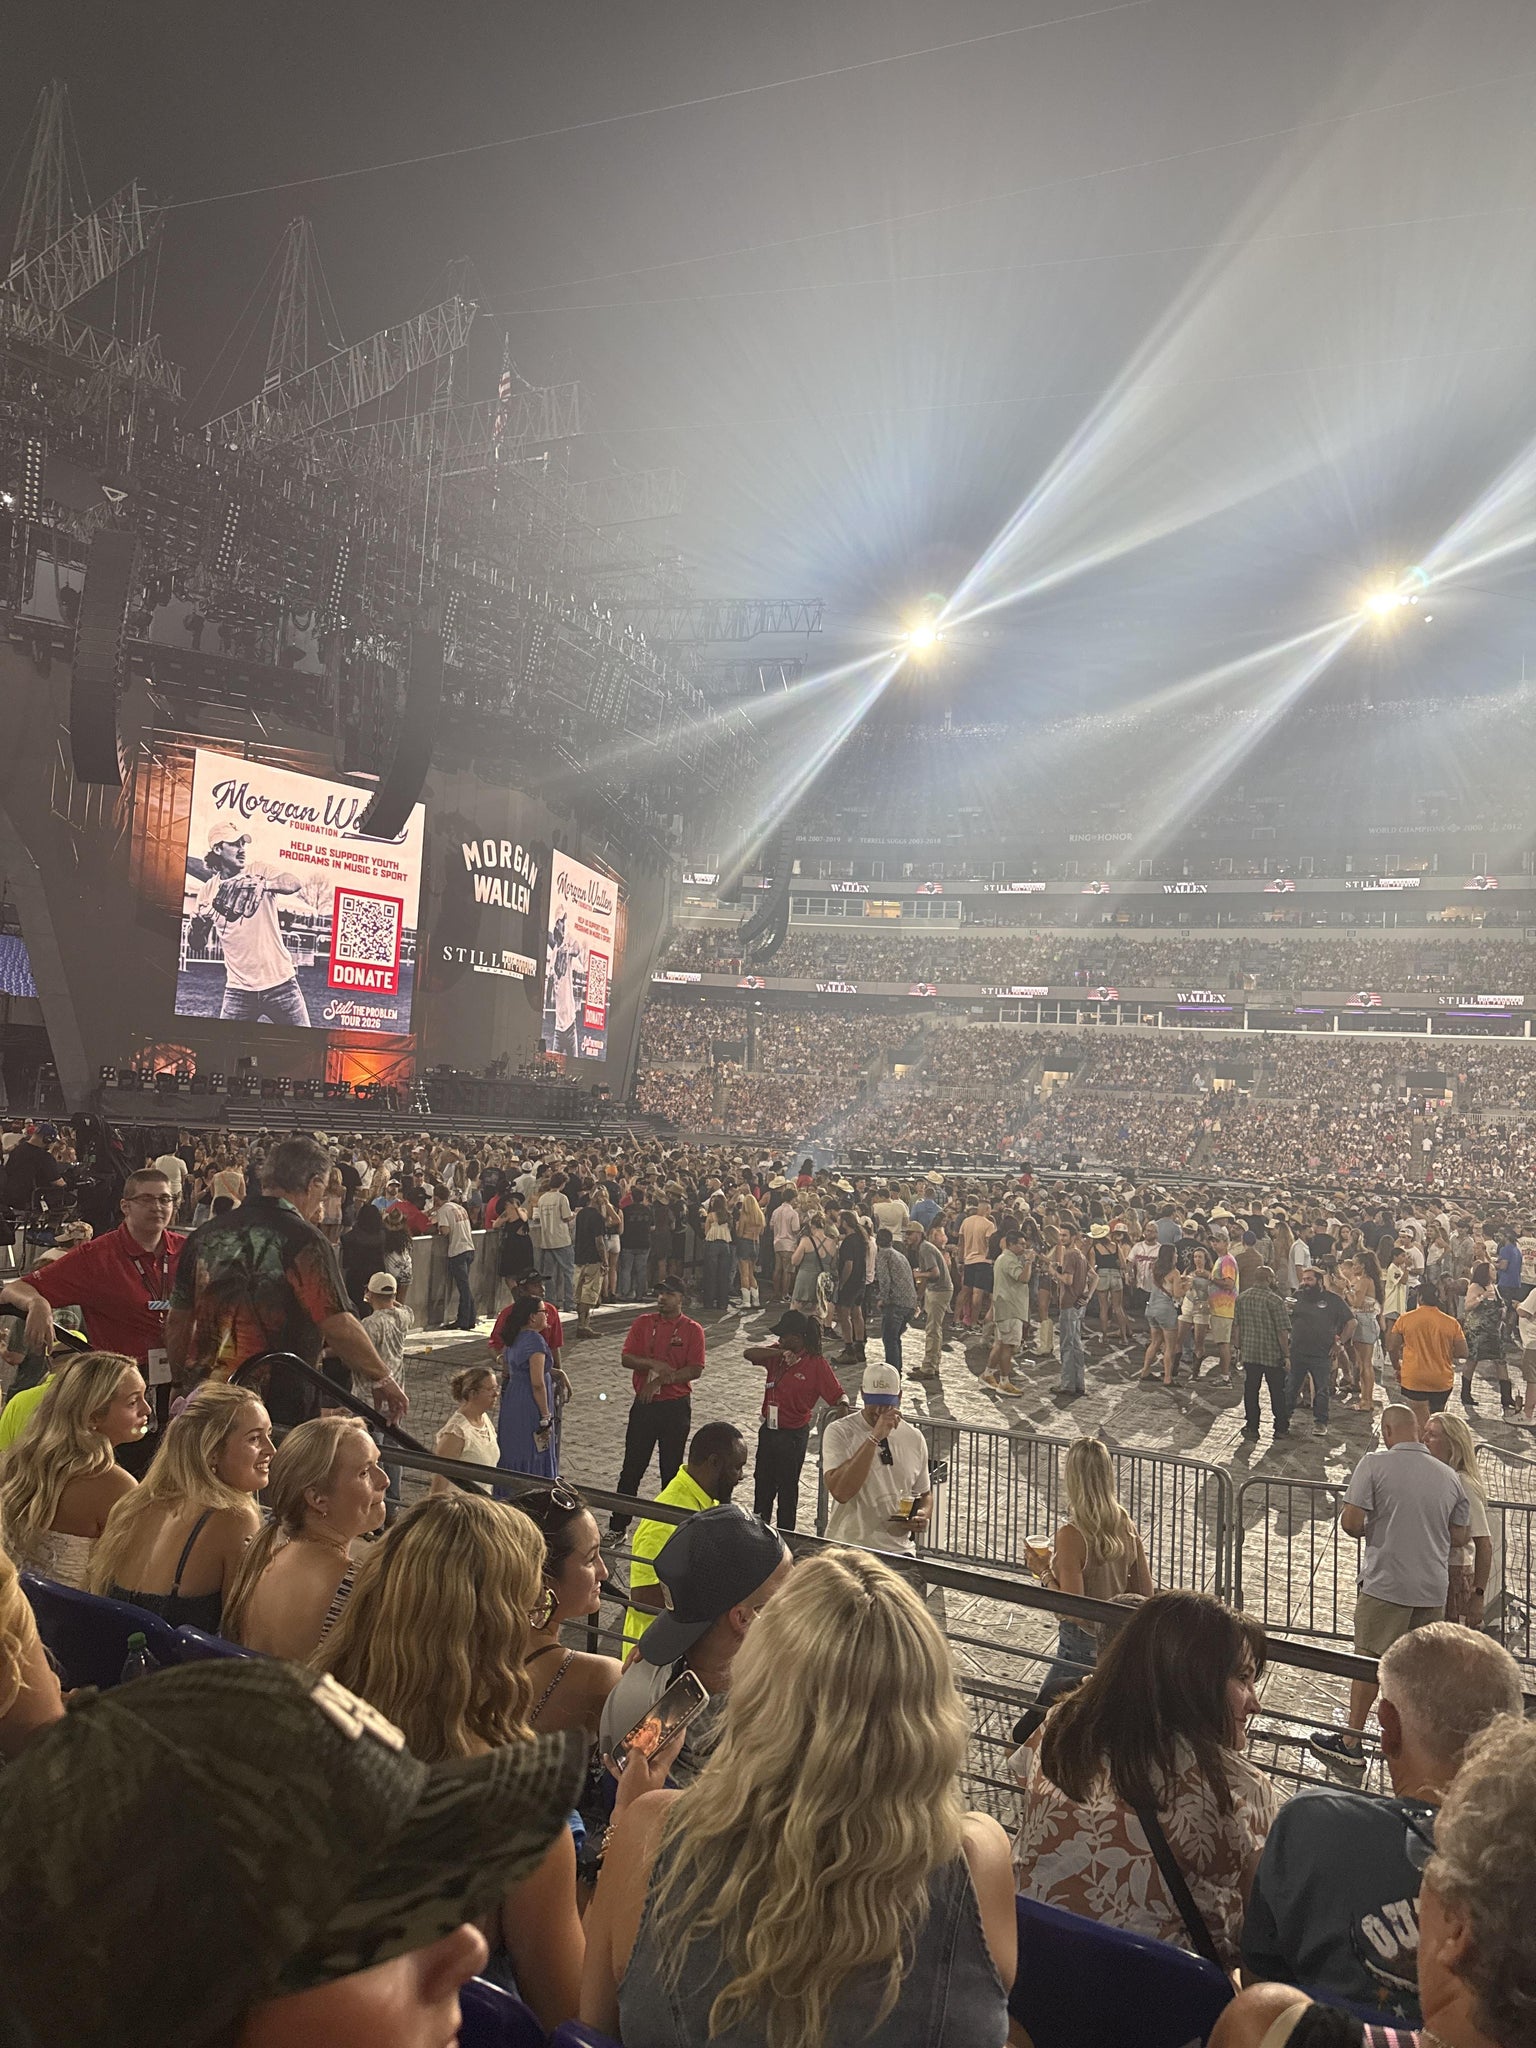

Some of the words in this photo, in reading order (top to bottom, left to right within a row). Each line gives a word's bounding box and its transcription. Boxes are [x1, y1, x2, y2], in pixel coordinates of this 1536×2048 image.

[212, 779, 320, 825] Morgan
[289, 820, 339, 838] FOUNDATION
[1369, 826, 1397, 834] WORLD
[1398, 824, 1445, 834] CHAMPIONS
[1069, 833, 1091, 842] RING
[1097, 832, 1133, 842] HONOR
[290, 840, 313, 852] HELP
[315, 844, 328, 855] US
[329, 848, 370, 865] SUPPORT
[371, 857, 399, 870] YOUTH
[279, 849, 330, 868] PROGRAMS
[332, 859, 342, 870] IN
[344, 862, 371, 875] MUSIC
[380, 868, 408, 882] SPORT
[462, 839, 538, 890] MORGAN
[831, 884, 870, 893] WALLEN
[983, 884, 1011, 892] STILL
[1163, 884, 1208, 894] WALLEN
[1344, 880, 1379, 889] STILL
[473, 873, 531, 915] WALLEN
[442, 945, 500, 968] STILL
[333, 964, 394, 989] DONATE
[816, 983, 858, 994] WALLEN
[981, 987, 1010, 995] STILL
[1177, 993, 1226, 1003] WALLEN
[1438, 996, 1477, 1005] STILL
[323, 999, 354, 1020] Still
[353, 1005, 366, 1016] THE
[366, 1006, 398, 1020] PROBLEM
[341, 1015, 360, 1026] TOUR
[361, 1018, 381, 1029] 2026
[872, 1380, 890, 1389] USA
[1361, 1897, 1420, 1959] OU
